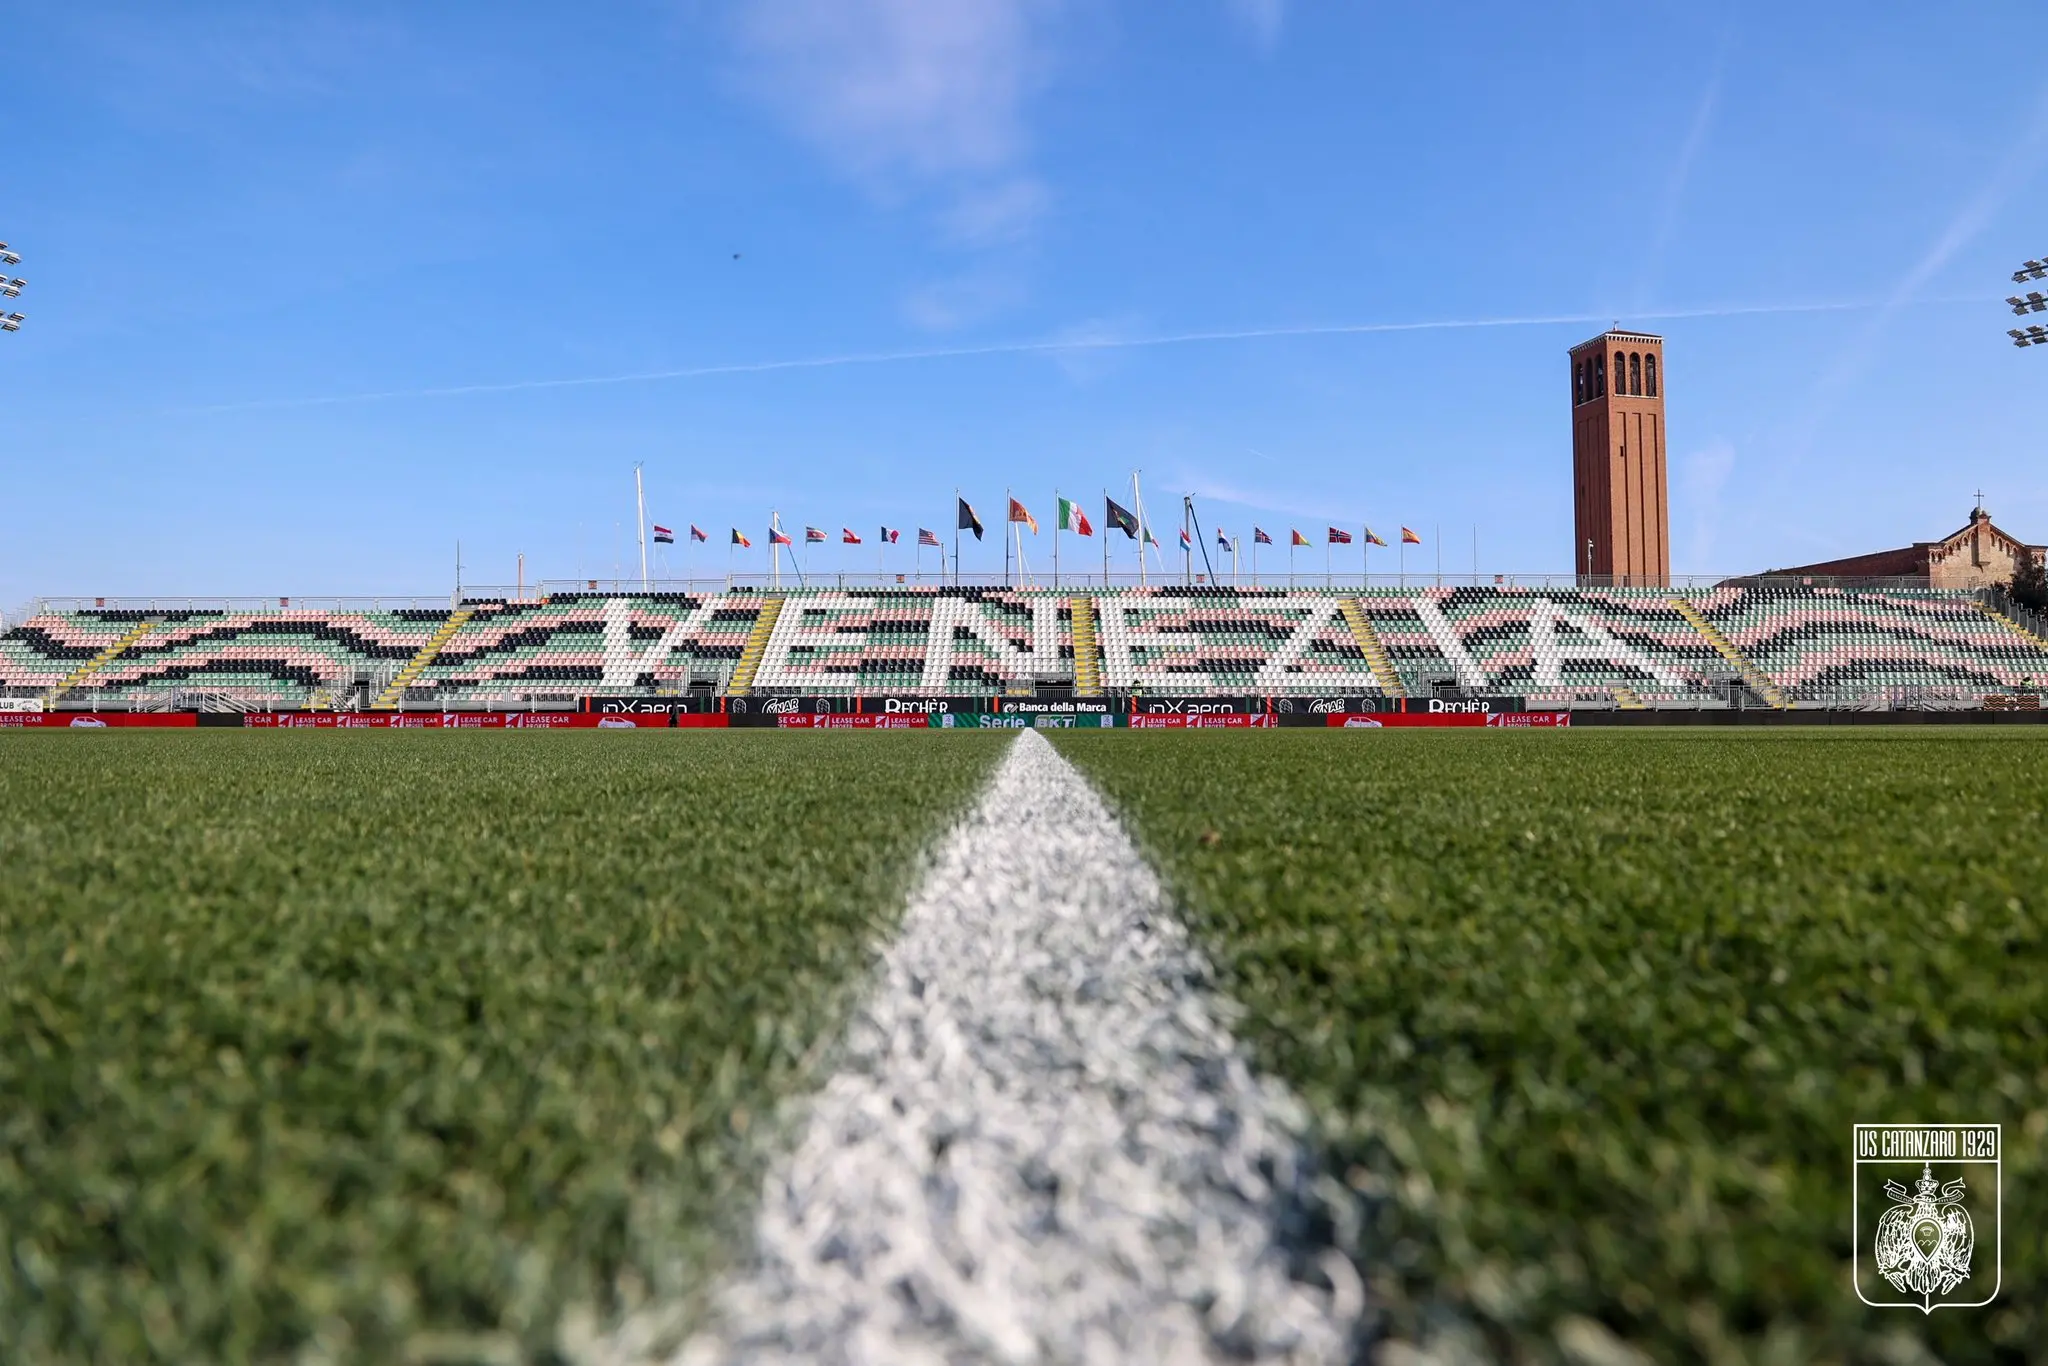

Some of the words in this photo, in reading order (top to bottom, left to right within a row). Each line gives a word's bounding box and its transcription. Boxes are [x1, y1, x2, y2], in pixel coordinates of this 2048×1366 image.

[597, 597, 1690, 688] VENEZIA
[1019, 703, 1048, 712] Banca
[1050, 703, 1074, 712] della
[1077, 703, 1106, 712] Marca
[979, 715, 1026, 728] Serie
[1036, 716, 1075, 728] BKT
